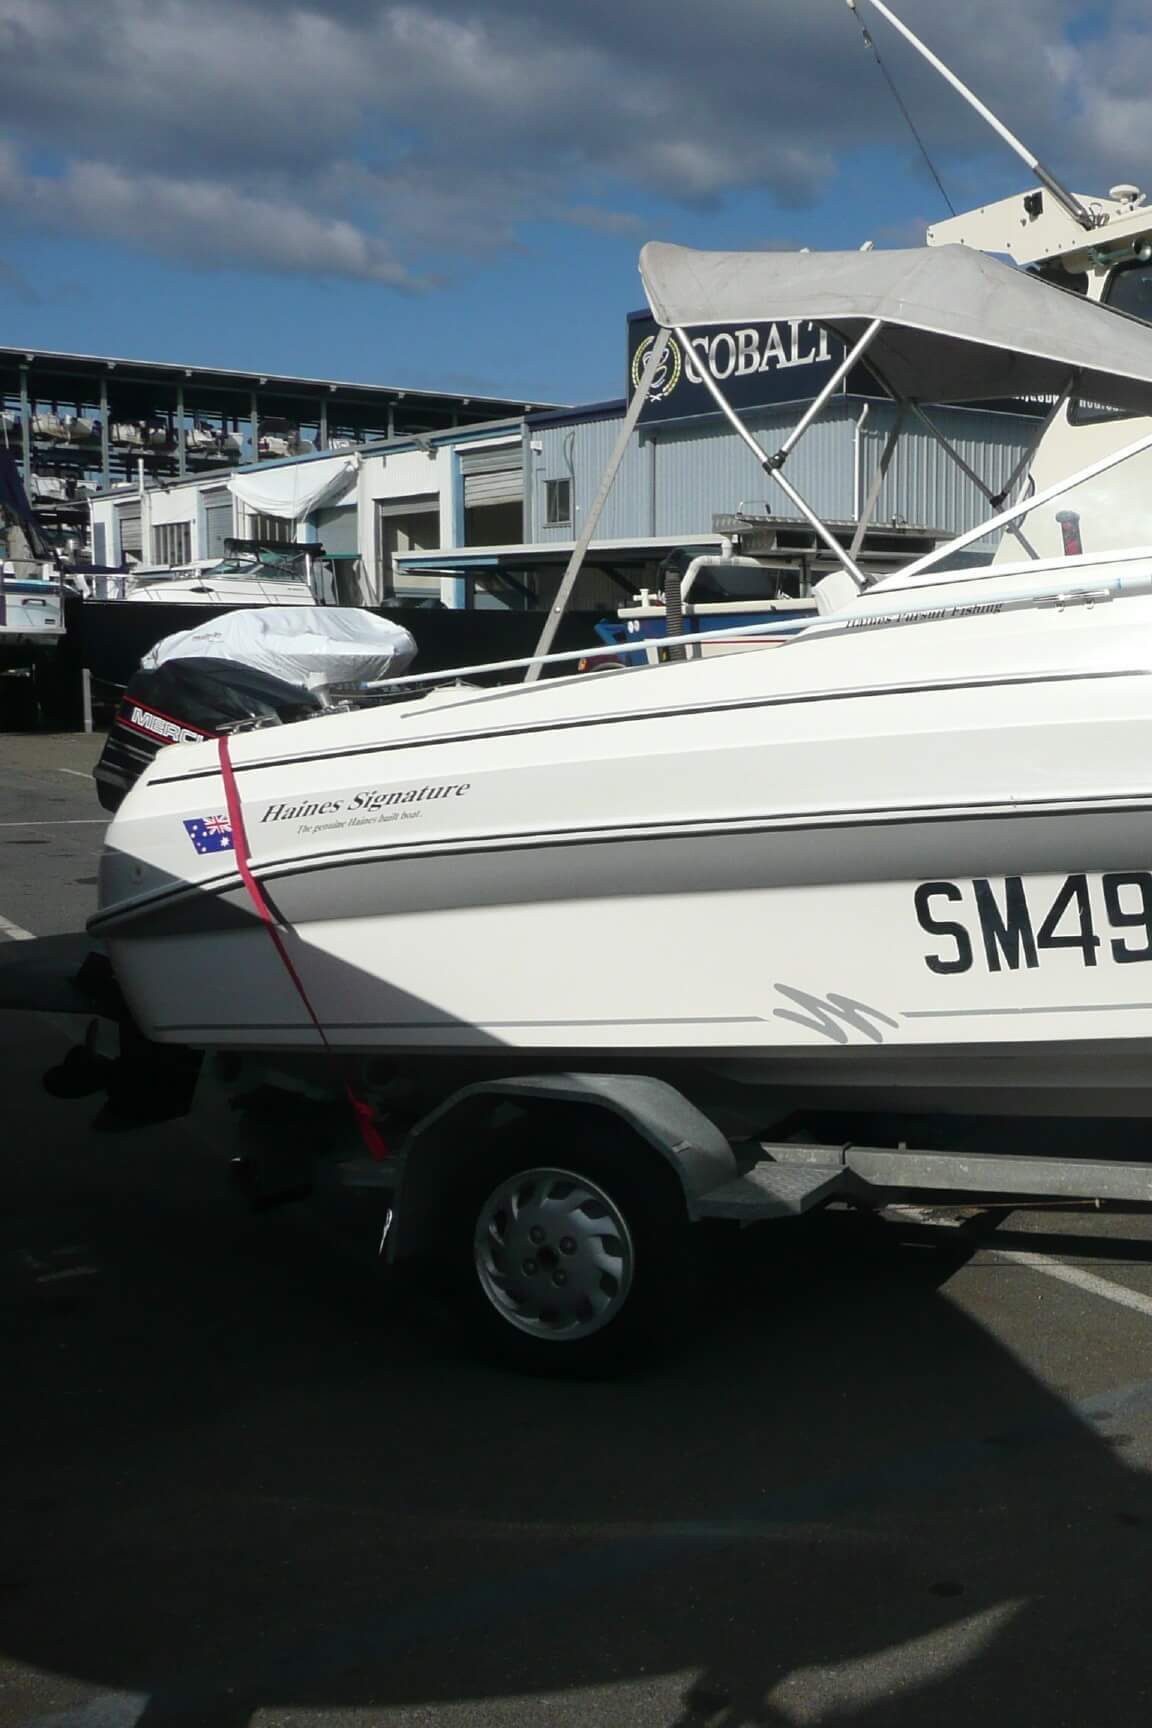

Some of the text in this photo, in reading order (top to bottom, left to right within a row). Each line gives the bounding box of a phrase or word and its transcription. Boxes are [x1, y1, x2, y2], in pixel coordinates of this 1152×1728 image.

[685, 320, 832, 384] COBALT
[260, 783, 471, 823] Haines Signature
[297, 824, 312, 835] The
[312, 820, 347, 834] genuine
[348, 816, 378, 827] Haines
[378, 811, 400, 823] built
